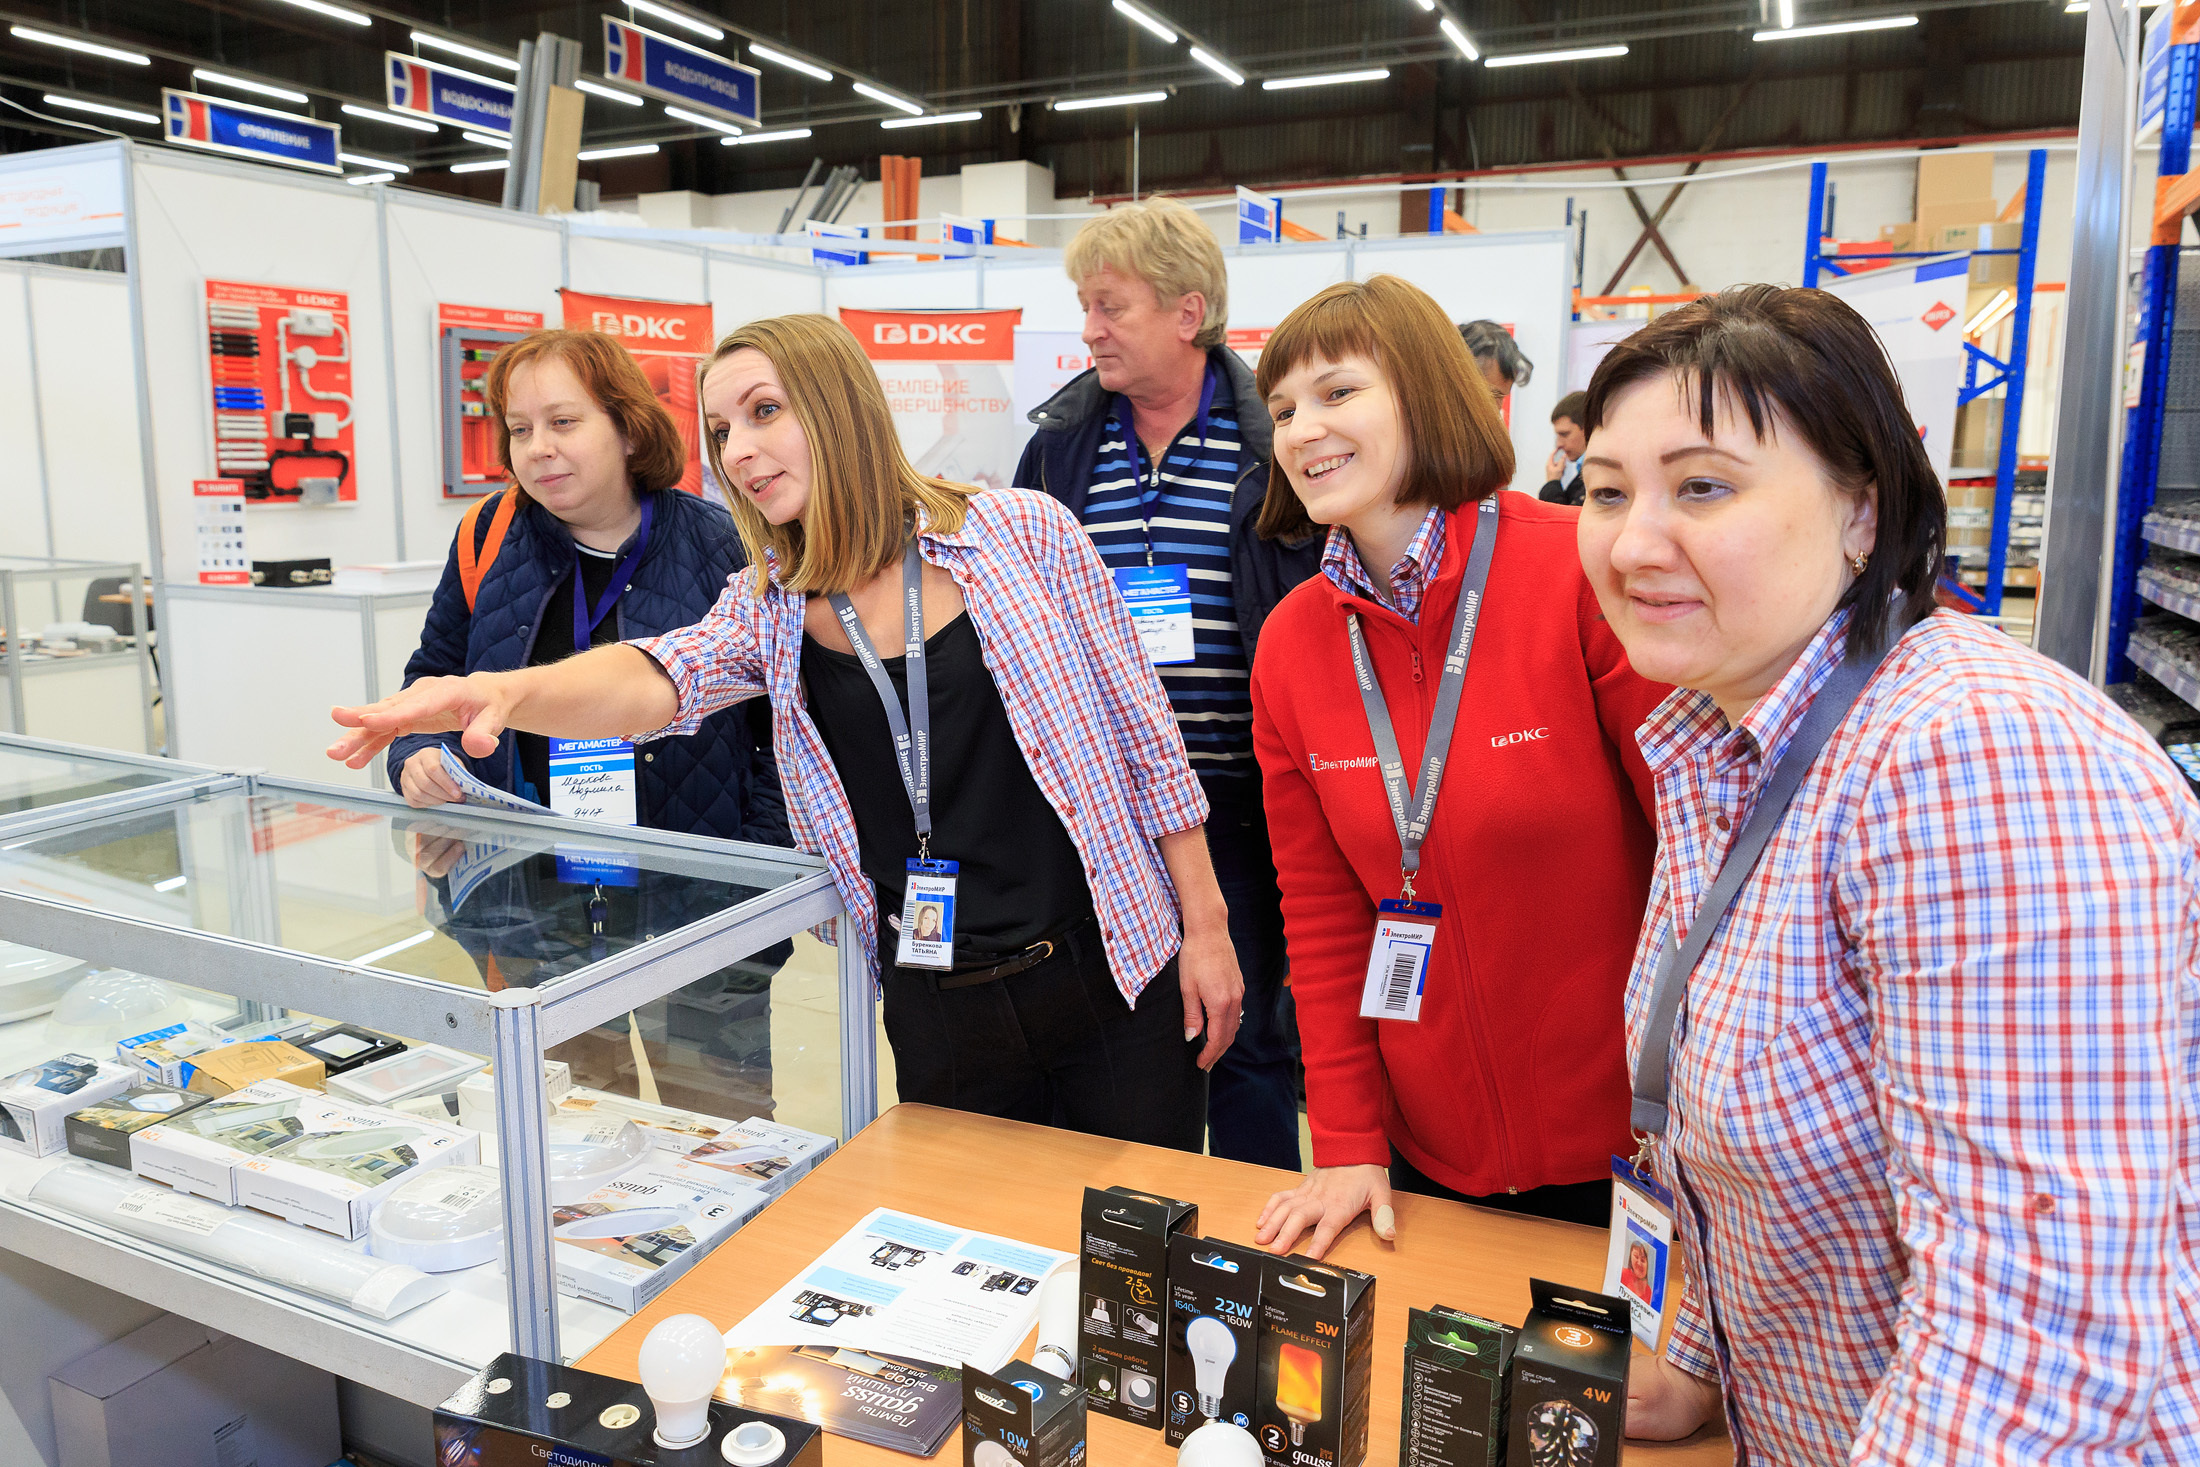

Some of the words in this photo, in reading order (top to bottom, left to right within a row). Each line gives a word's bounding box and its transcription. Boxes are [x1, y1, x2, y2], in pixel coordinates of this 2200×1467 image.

[664, 60, 739, 99] ВОДОПРОВОД
[237, 122, 312, 149] ОТОПЛЕНИЕ
[624, 315, 686, 340] DKC
[910, 324, 986, 344] DKC
[882, 379, 970, 394] ЕМЛЕНИЕ
[890, 398, 1011, 413] ВЕРШЕНСТВУ
[909, 587, 921, 642] ЭлектроМИР
[1455, 590, 1479, 656] ЭлектроМИР
[846, 620, 878, 669] ЭлектроМИР
[1351, 630, 1373, 691] ЭлектроМИР
[1508, 727, 1550, 744] DKC
[558, 739, 624, 751] МЕГАМАСТЕР
[917, 730, 929, 788] ЭлектроМИР
[1320, 756, 1378, 770] ЭлектроМИР
[1417, 756, 1442, 824] ЭлектроМИР
[1390, 931, 1423, 940] ЭлектроМИР
[607, 1181, 664, 1197] gauss
[707, 1207, 725, 1218] 3
[1626, 1204, 1658, 1233] ЭлектроМИР
[1092, 1257, 1106, 1266] Свет
[1106, 1261, 1117, 1270] без
[1118, 1266, 1152, 1278] проводов!
[1174, 1285, 1194, 1295] Lifetime
[1214, 1297, 1253, 1318] 22W
[1264, 1305, 1285, 1315] Lifetime
[1550, 1304, 1612, 1322] www.gauss.ru
[1271, 1324, 1298, 1339] FLAME
[1300, 1334, 1332, 1349] EFFECT
[1315, 1321, 1339, 1338] 5W
[1566, 1330, 1581, 1341] 3
[1098, 1347, 1123, 1359] режима
[1123, 1354, 1148, 1365] работы
[885, 1371, 938, 1393] выбор
[1521, 1370, 1534, 1378] Срок
[1535, 1373, 1556, 1384] службы
[840, 1386, 925, 1414] gauss
[1178, 1395, 1188, 1408] 5
[1583, 1387, 1612, 1403] 4W
[857, 1405, 917, 1428] Лампы
[1170, 1415, 1186, 1426] E27
[999, 1428, 1029, 1449] 10W
[1170, 1429, 1185, 1440] LED
[1268, 1429, 1279, 1445] 2
[1292, 1450, 1333, 1467] gauss
